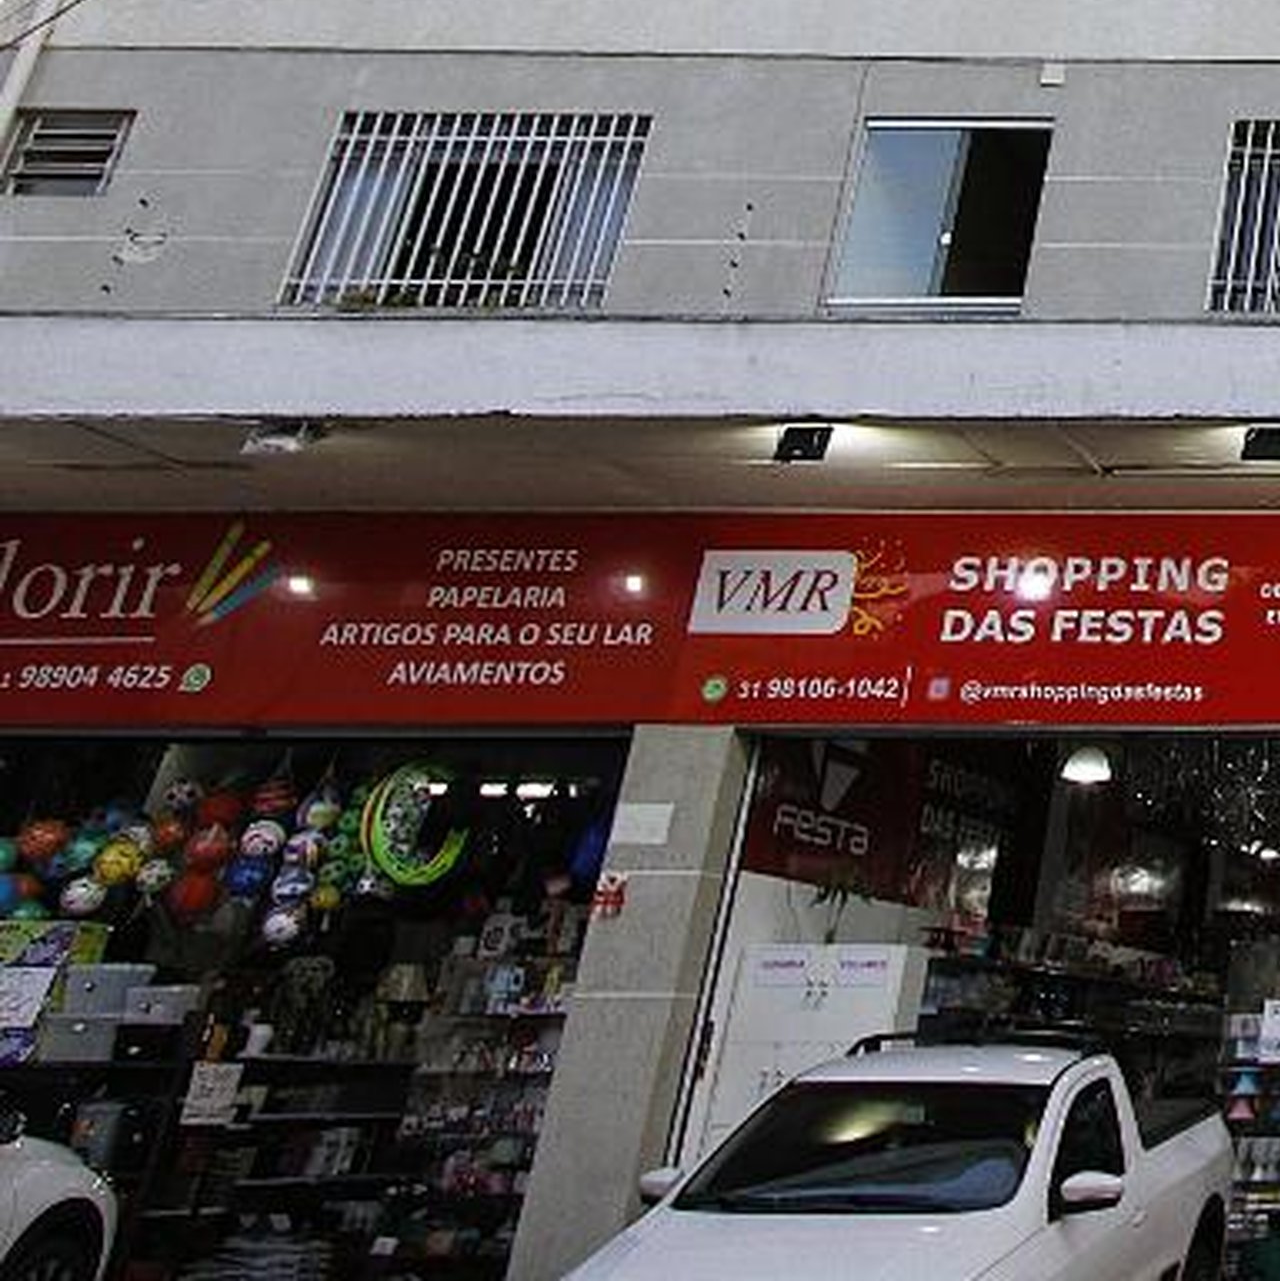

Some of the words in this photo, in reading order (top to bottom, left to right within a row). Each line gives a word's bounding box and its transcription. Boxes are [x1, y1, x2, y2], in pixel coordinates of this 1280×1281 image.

[436, 549, 578, 572] PRESENTES
[949, 555, 1230, 593] SHOPPING
[427, 585, 566, 609] PAPELARIA
[713, 567, 840, 616] VMR
[320, 624, 436, 647] ARTIGOS
[441, 624, 512, 647] PARA
[517, 623, 541, 646] O
[545, 623, 597, 646] SEU
[600, 623, 653, 646] LAR
[940, 608, 1035, 645] DAS
[1049, 608, 1225, 644] FESTAS
[386, 661, 566, 686] AVIAMENTOS
